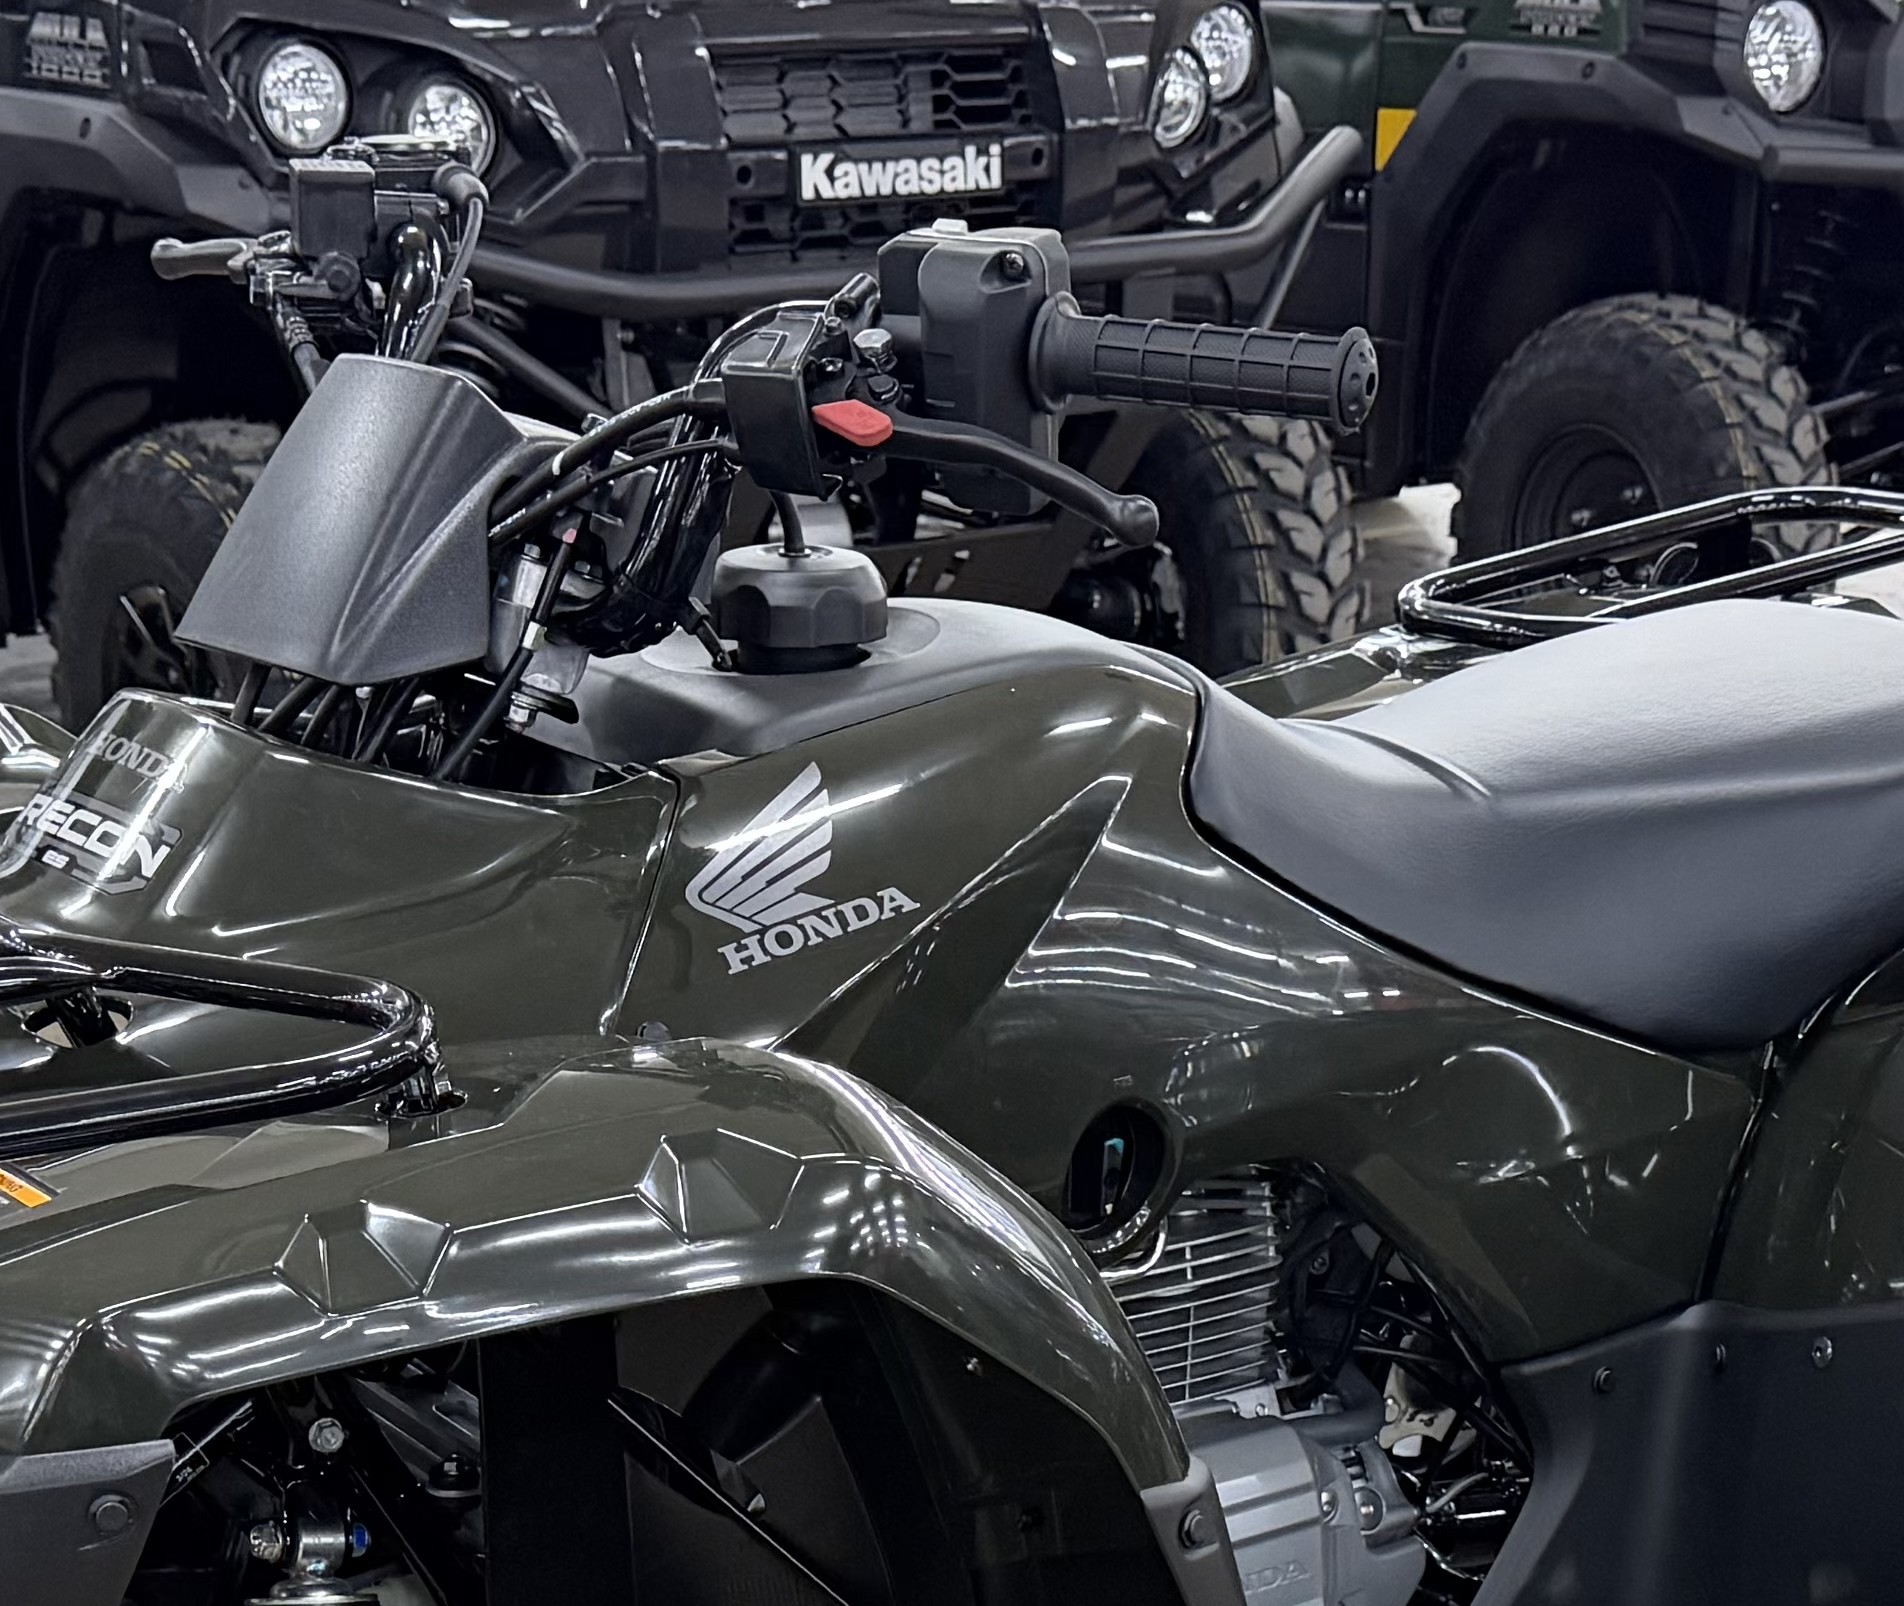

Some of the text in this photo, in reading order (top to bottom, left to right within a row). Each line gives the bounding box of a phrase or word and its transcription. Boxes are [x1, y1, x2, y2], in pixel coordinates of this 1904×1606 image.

[800, 143, 1002, 201] Kawasaki
[17, 793, 171, 878] RECON
[41, 849, 70, 869] ES
[717, 886, 921, 975] HONDA
